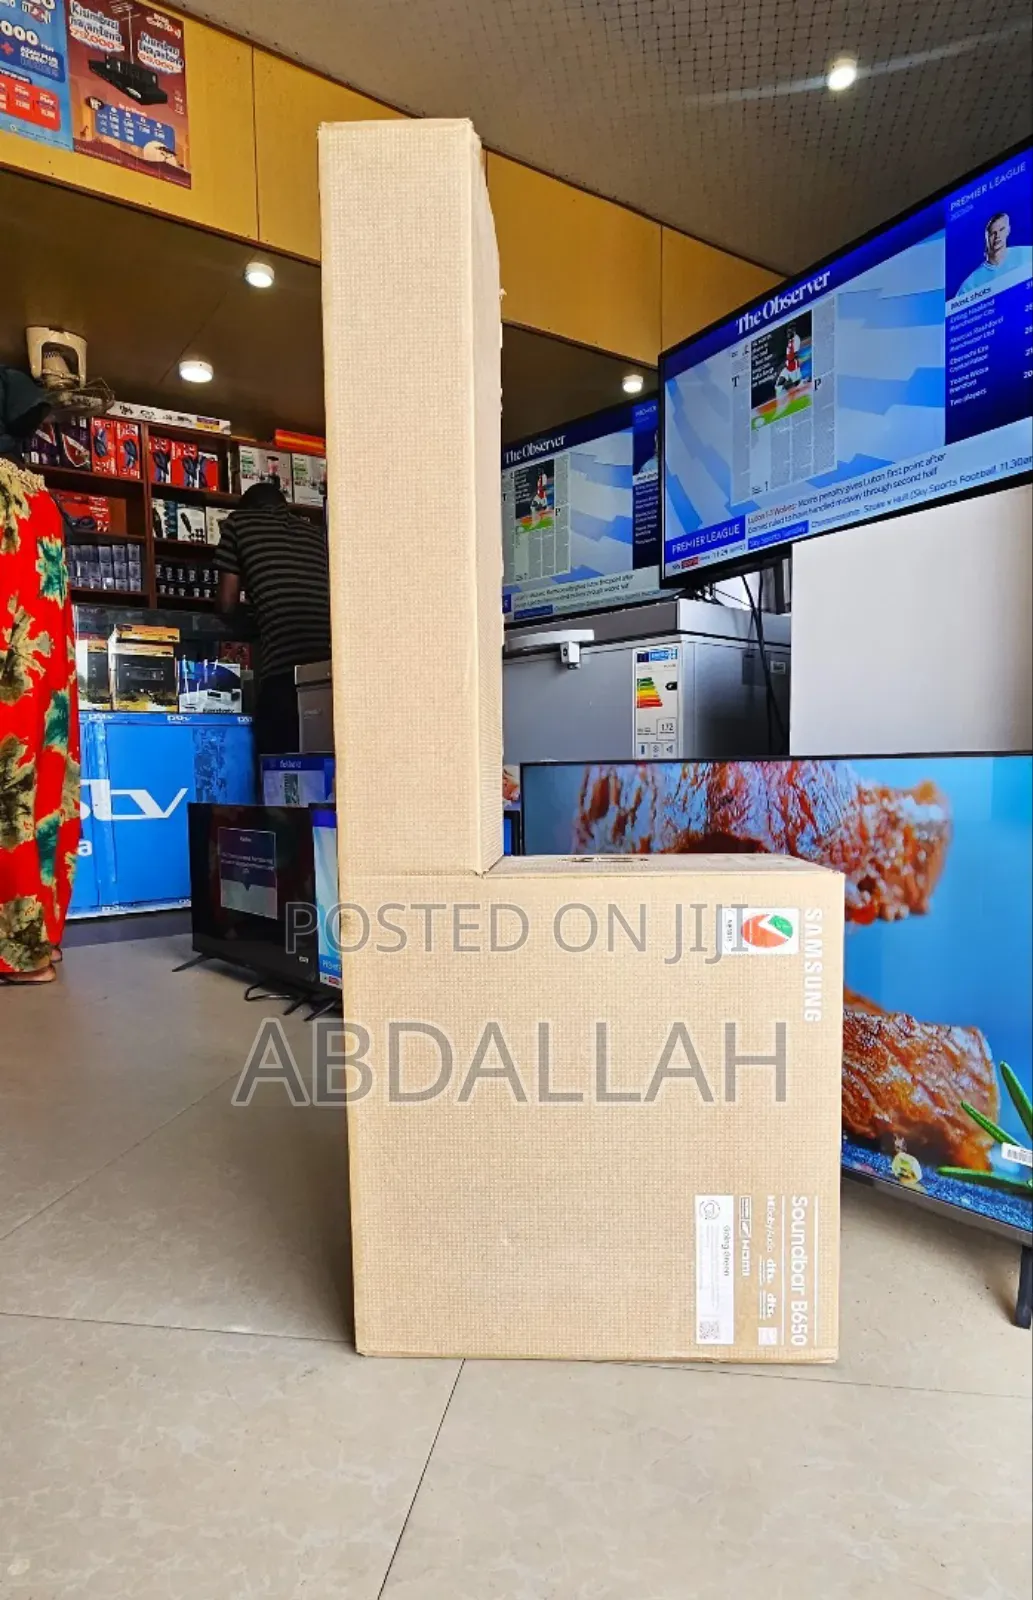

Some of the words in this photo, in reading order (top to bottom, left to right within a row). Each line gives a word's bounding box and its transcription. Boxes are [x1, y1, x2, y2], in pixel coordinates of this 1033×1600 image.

[950, 184, 987, 211] PREMIER
[989, 161, 1026, 189] LEAGUE
[735, 311, 762, 335] The
[762, 270, 831, 320] Observer
[970, 287, 992, 301] shots
[504, 448, 520, 465] The
[521, 434, 566, 458] Observer
[819, 487, 844, 503] penalty
[844, 480, 862, 494] gives
[863, 472, 886, 486] Luton
[886, 465, 903, 479] first
[903, 460, 924, 476] point
[925, 452, 947, 466] after
[835, 492, 862, 508] midway
[863, 478, 893, 498] through
[893, 474, 921, 488] second
[922, 466, 939, 479] half
[928, 478, 957, 494] Sports
[672, 536, 706, 555] PREMIER
[706, 523, 740, 543] LEAGUE
[804, 908, 823, 1022] SAMSUNG
[721, 1225, 731, 1250] Going
[791, 1196, 808, 1296] Soundbar
[722, 1251, 731, 1277] Green
[791, 1300, 808, 1346] B650
